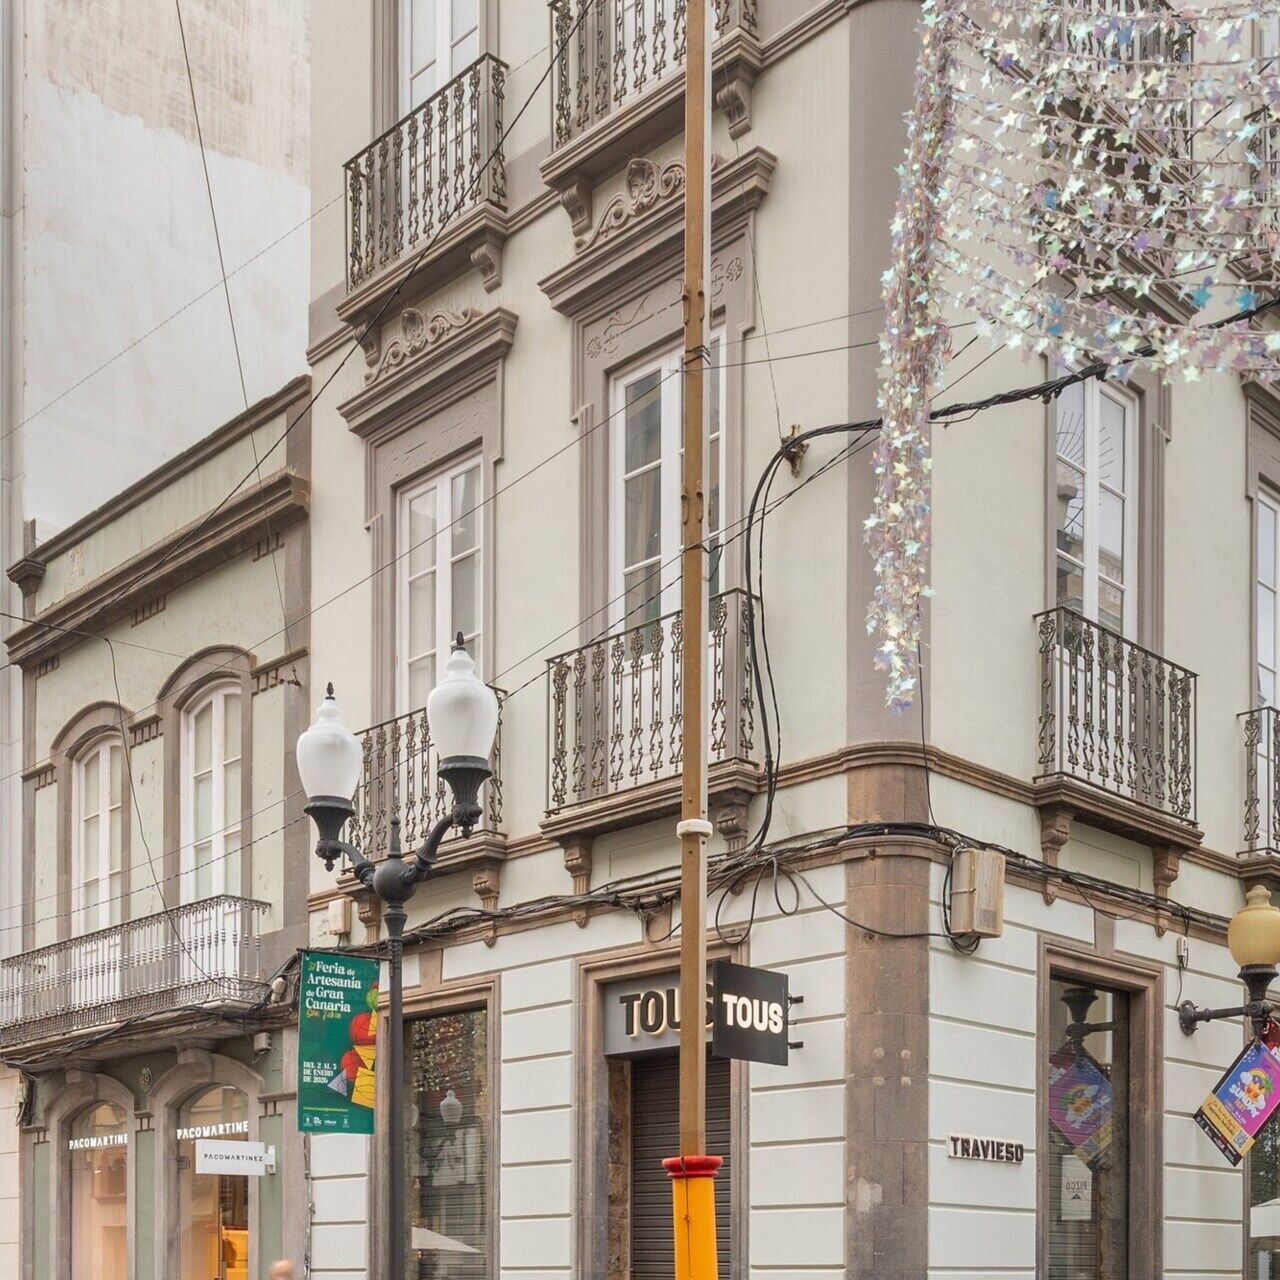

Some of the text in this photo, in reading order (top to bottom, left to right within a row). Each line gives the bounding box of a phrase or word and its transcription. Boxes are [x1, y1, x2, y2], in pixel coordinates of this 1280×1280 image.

[316, 961, 345, 975] Feria
[346, 968, 356, 976] de
[307, 973, 362, 989] Artesanía
[305, 986, 344, 1000] de Gran
[305, 997, 351, 1013] Canaria
[722, 993, 784, 1034] TOUS
[303, 1061, 314, 1069] DEL
[303, 1068, 334, 1077] DE ENERO
[303, 1075, 312, 1083] DE
[177, 1120, 249, 1140] PACOMARTINE
[69, 1133, 129, 1150] PACOMARTINE
[950, 1136, 1024, 1162] TRAVIESO
[204, 1153, 264, 1163] PACOMARTINEZ
